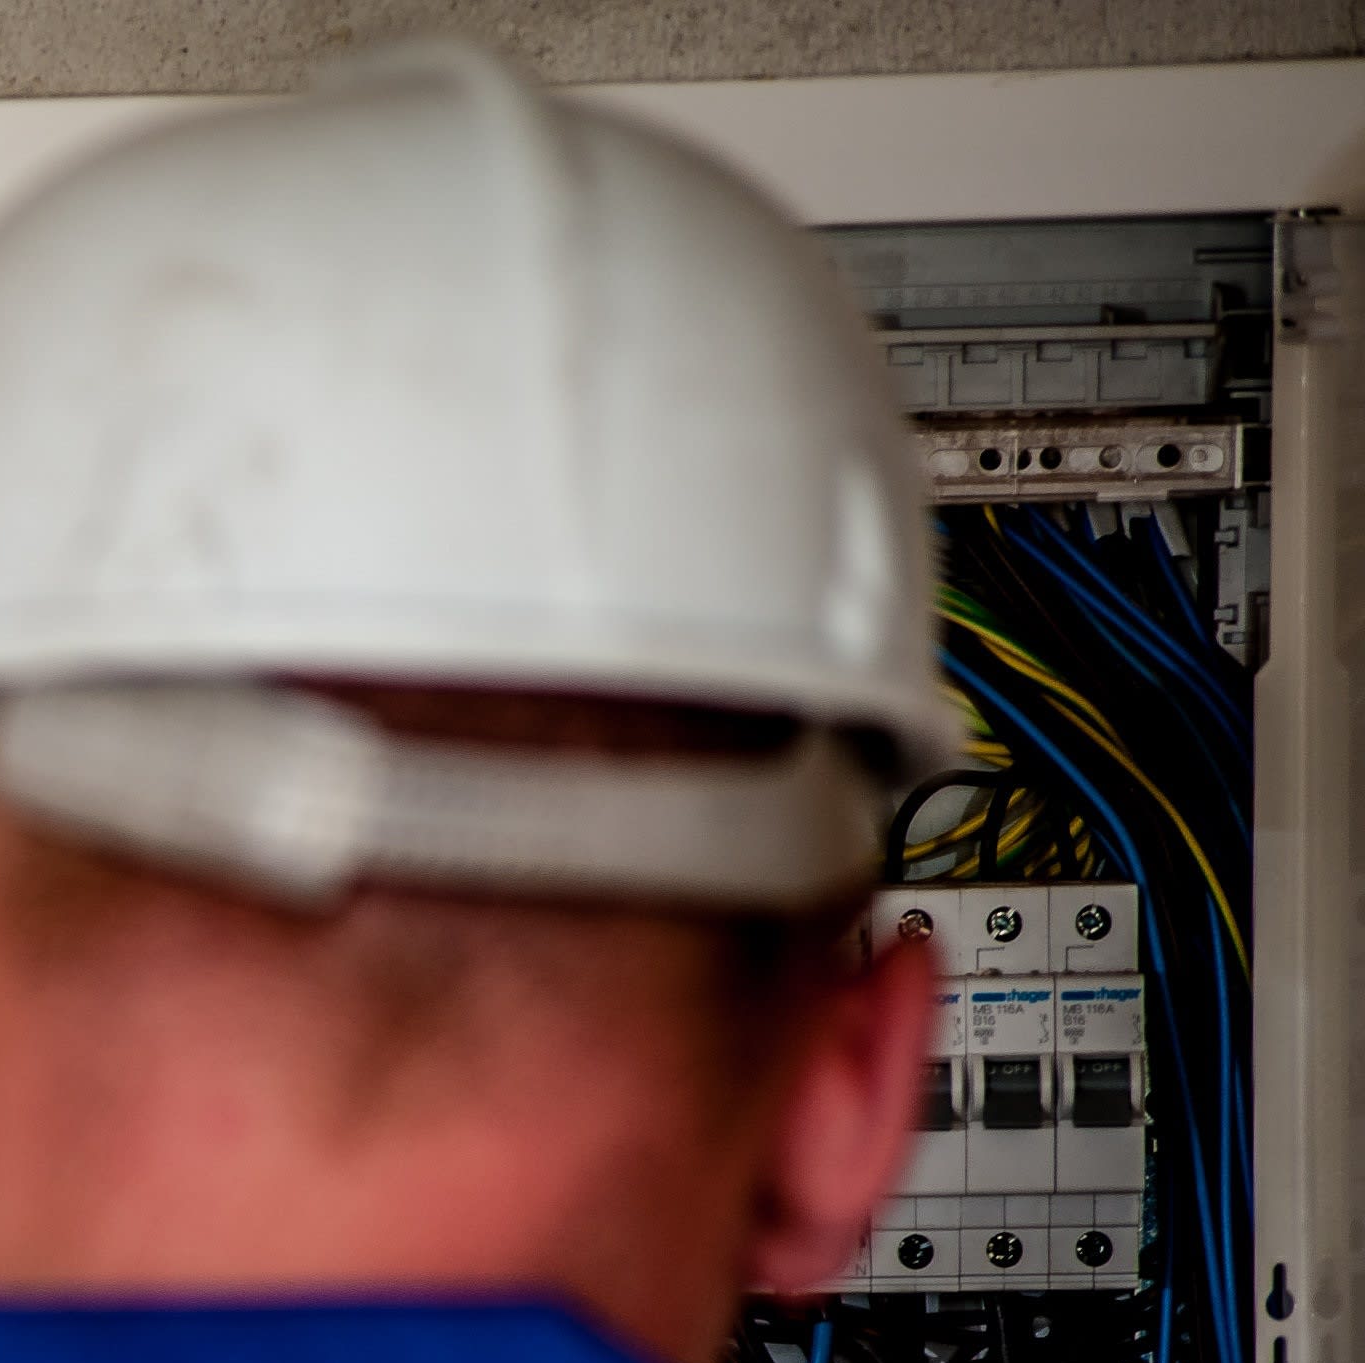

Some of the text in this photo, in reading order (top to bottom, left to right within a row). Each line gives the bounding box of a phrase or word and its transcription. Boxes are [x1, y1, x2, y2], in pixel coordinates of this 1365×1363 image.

[1010, 989, 1052, 1003] hager
[1099, 987, 1141, 1003] hager
[997, 1004, 1025, 1015] 116A
[1086, 1004, 1115, 1014] 116A
